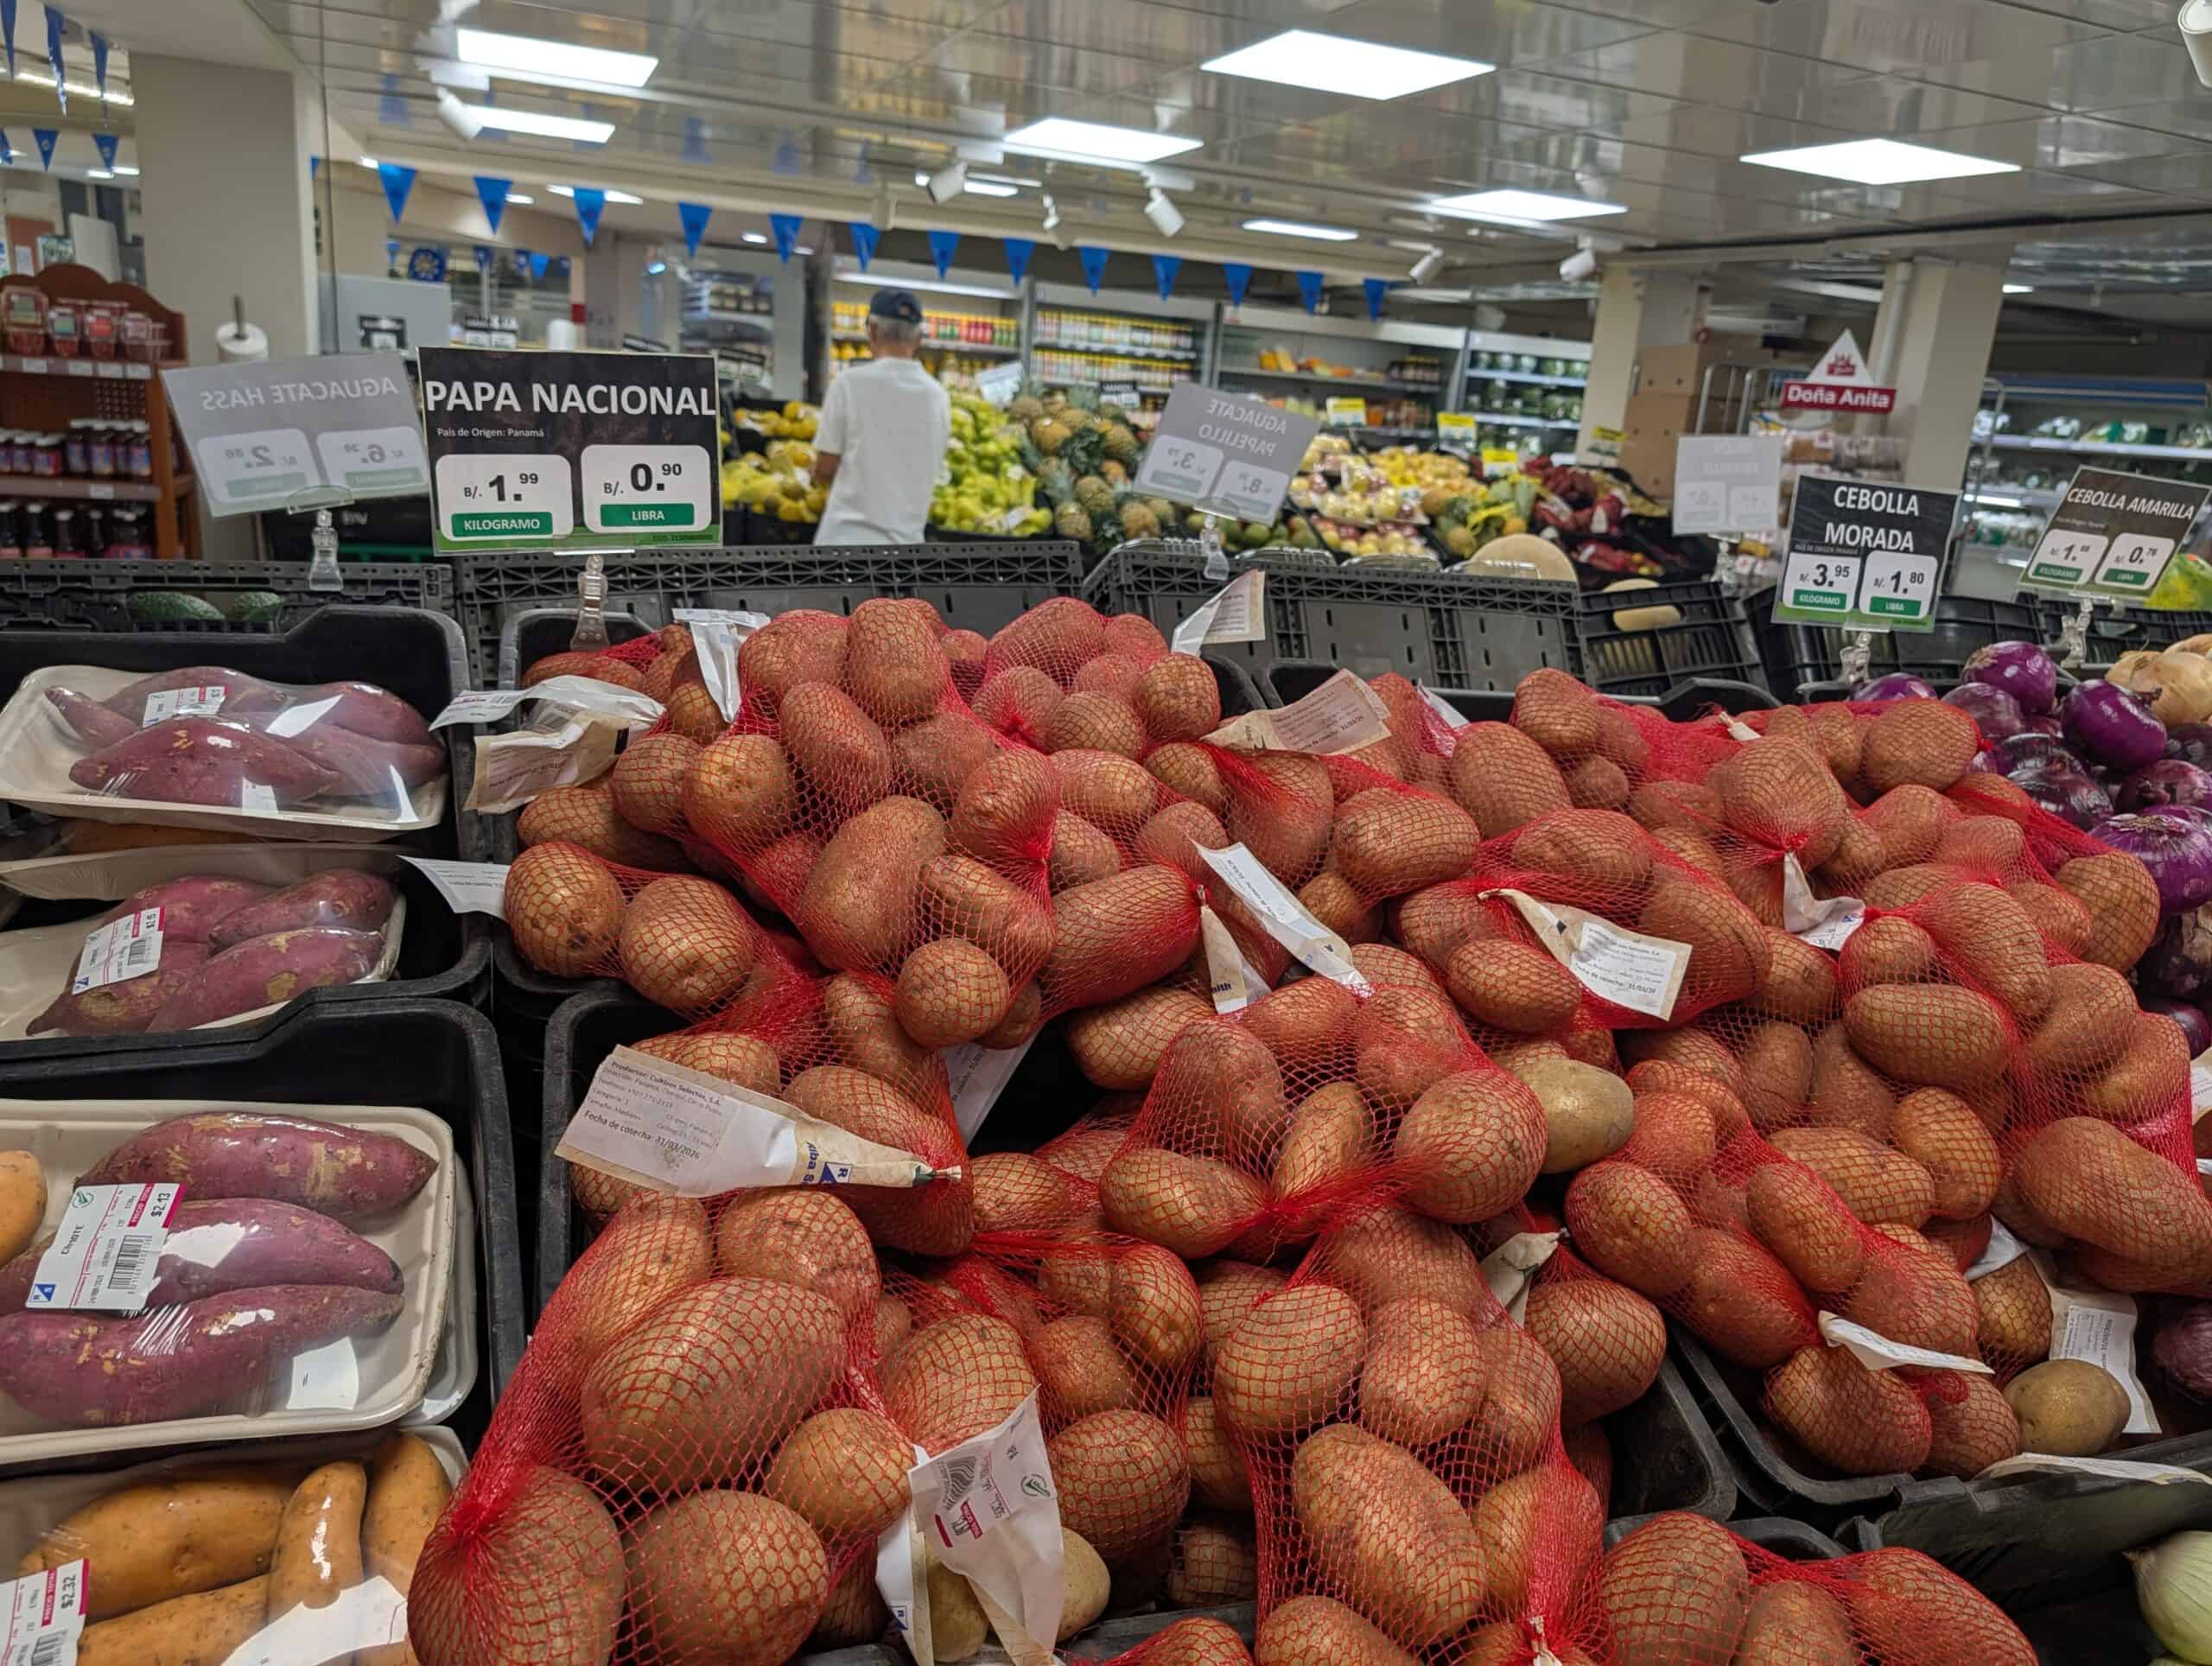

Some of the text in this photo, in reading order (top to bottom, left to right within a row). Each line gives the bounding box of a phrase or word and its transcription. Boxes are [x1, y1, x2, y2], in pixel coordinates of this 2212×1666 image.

[424, 381, 716, 416] PAPA NACIONAL
[1788, 386, 1891, 408] Doña Anita
[458, 428, 471, 437] de
[472, 428, 505, 440] Origen:
[508, 428, 545, 438] Panamá
[463, 473, 539, 502] B/. 1.99
[604, 463, 683, 496] B/. 0.90
[1834, 486, 1920, 517] CEBOLLA
[2067, 487, 2195, 519] CEBOLLA AMARILLA
[464, 519, 541, 531] KILOGRAMO
[632, 511, 665, 522] LIBRA
[1824, 522, 1915, 552] MORADA
[1813, 563, 1851, 588] 3.95
[1890, 569, 1925, 595] 1.80
[1799, 595, 1840, 605] KILOGRAMO
[1885, 602, 1904, 612] LIBRA
[584, 1110, 607, 1126] Fecha
[608, 1121, 620, 1129] de
[620, 1125, 653, 1141] cosecha:
[150, 1192, 171, 1218] $2.13
